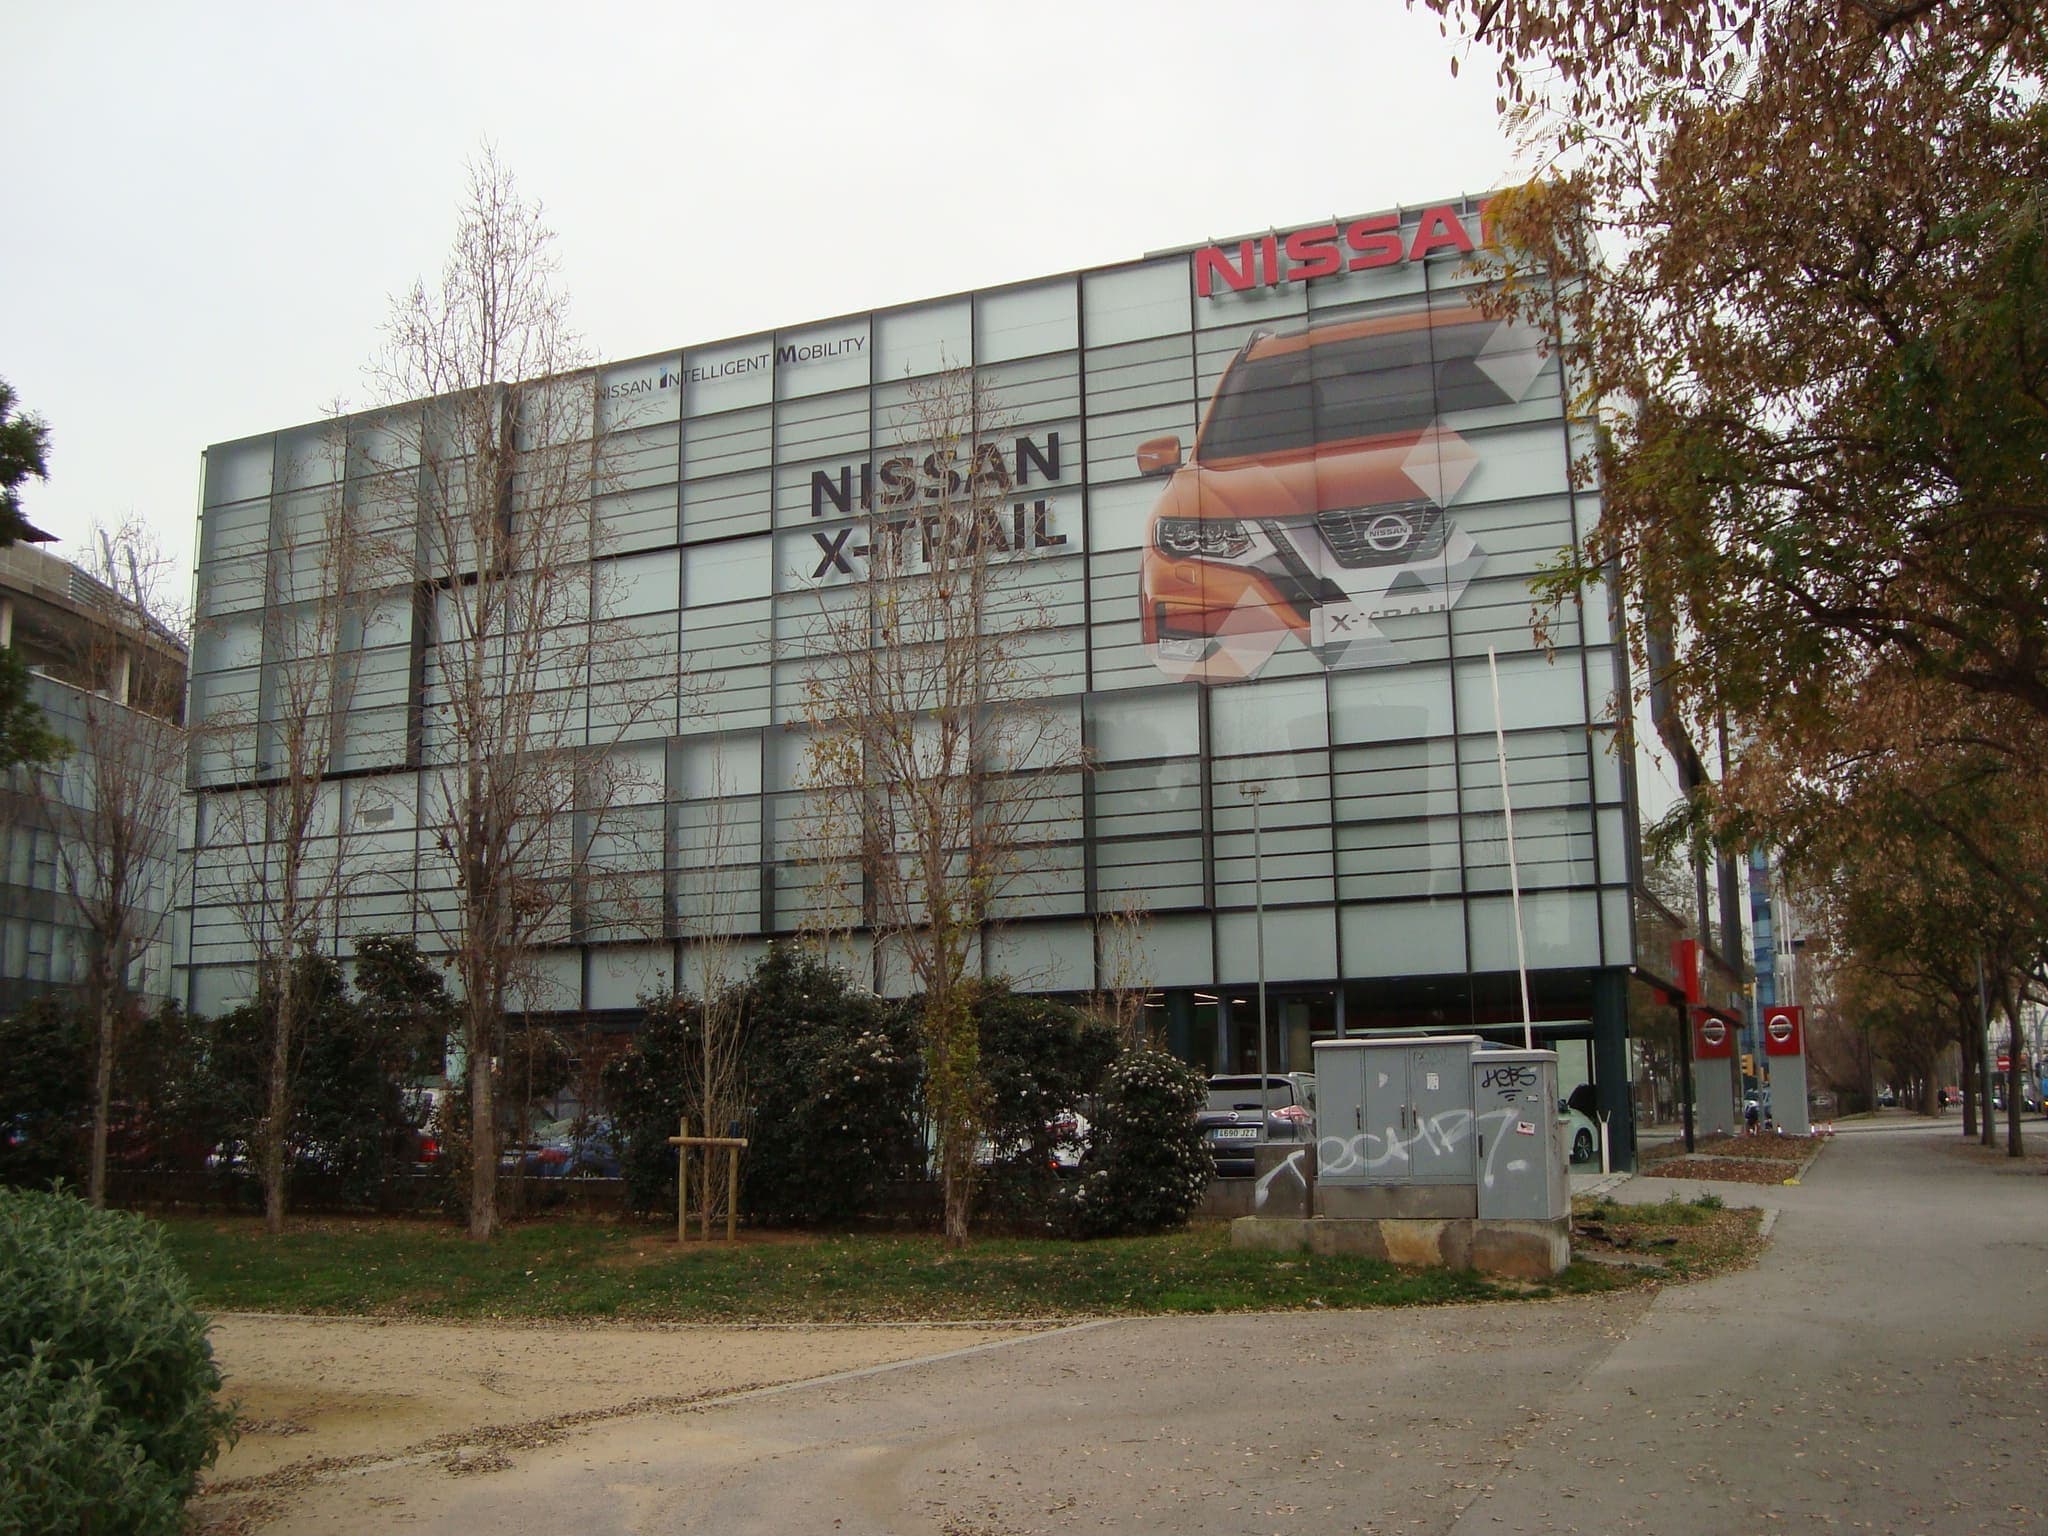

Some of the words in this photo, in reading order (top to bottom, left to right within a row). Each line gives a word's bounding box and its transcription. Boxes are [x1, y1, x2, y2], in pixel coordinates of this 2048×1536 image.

[776, 335, 866, 367] MOBILITY
[811, 431, 1061, 517] NISSAN
[1369, 526, 1409, 537] NISSAN
